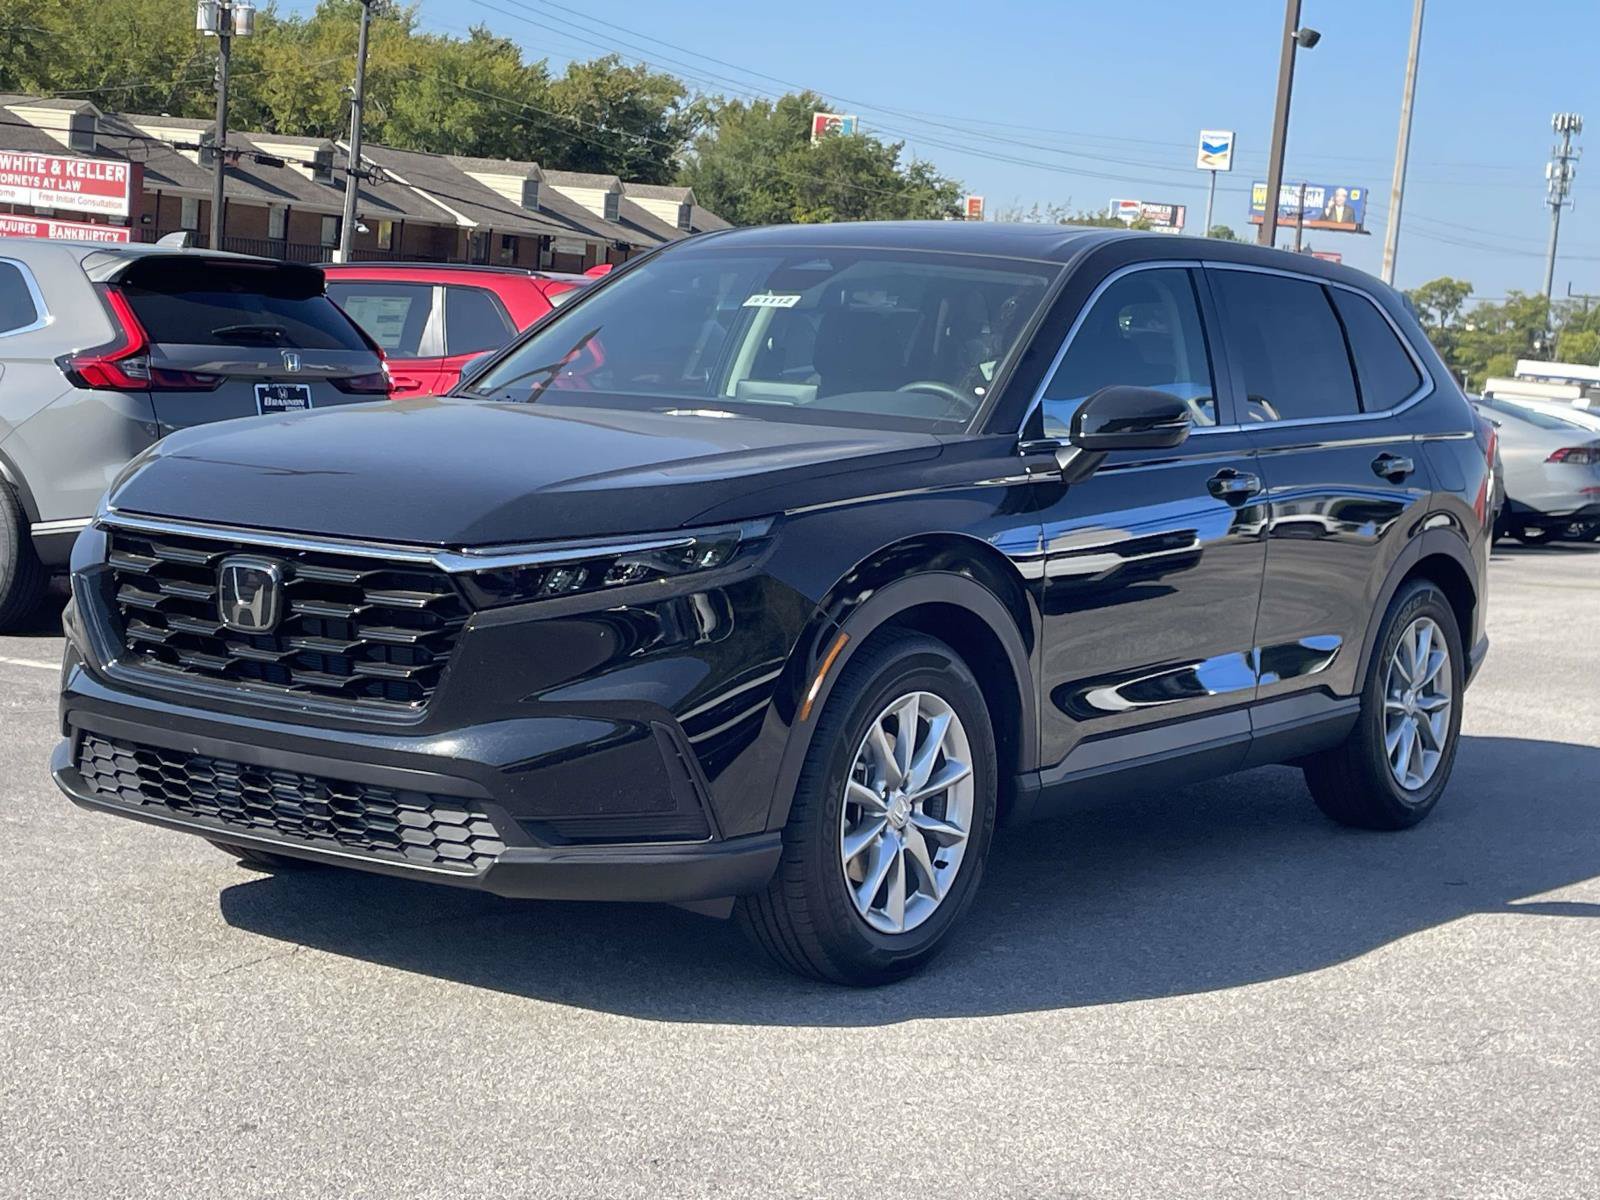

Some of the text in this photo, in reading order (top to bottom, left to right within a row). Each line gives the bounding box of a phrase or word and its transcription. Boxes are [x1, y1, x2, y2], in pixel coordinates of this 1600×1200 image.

[0, 155, 125, 182] WHITE & KELLER
[0, 173, 81, 191] ORNEYS AT LAW
[38, 192, 54, 201] Free
[78, 196, 122, 209] Consultation
